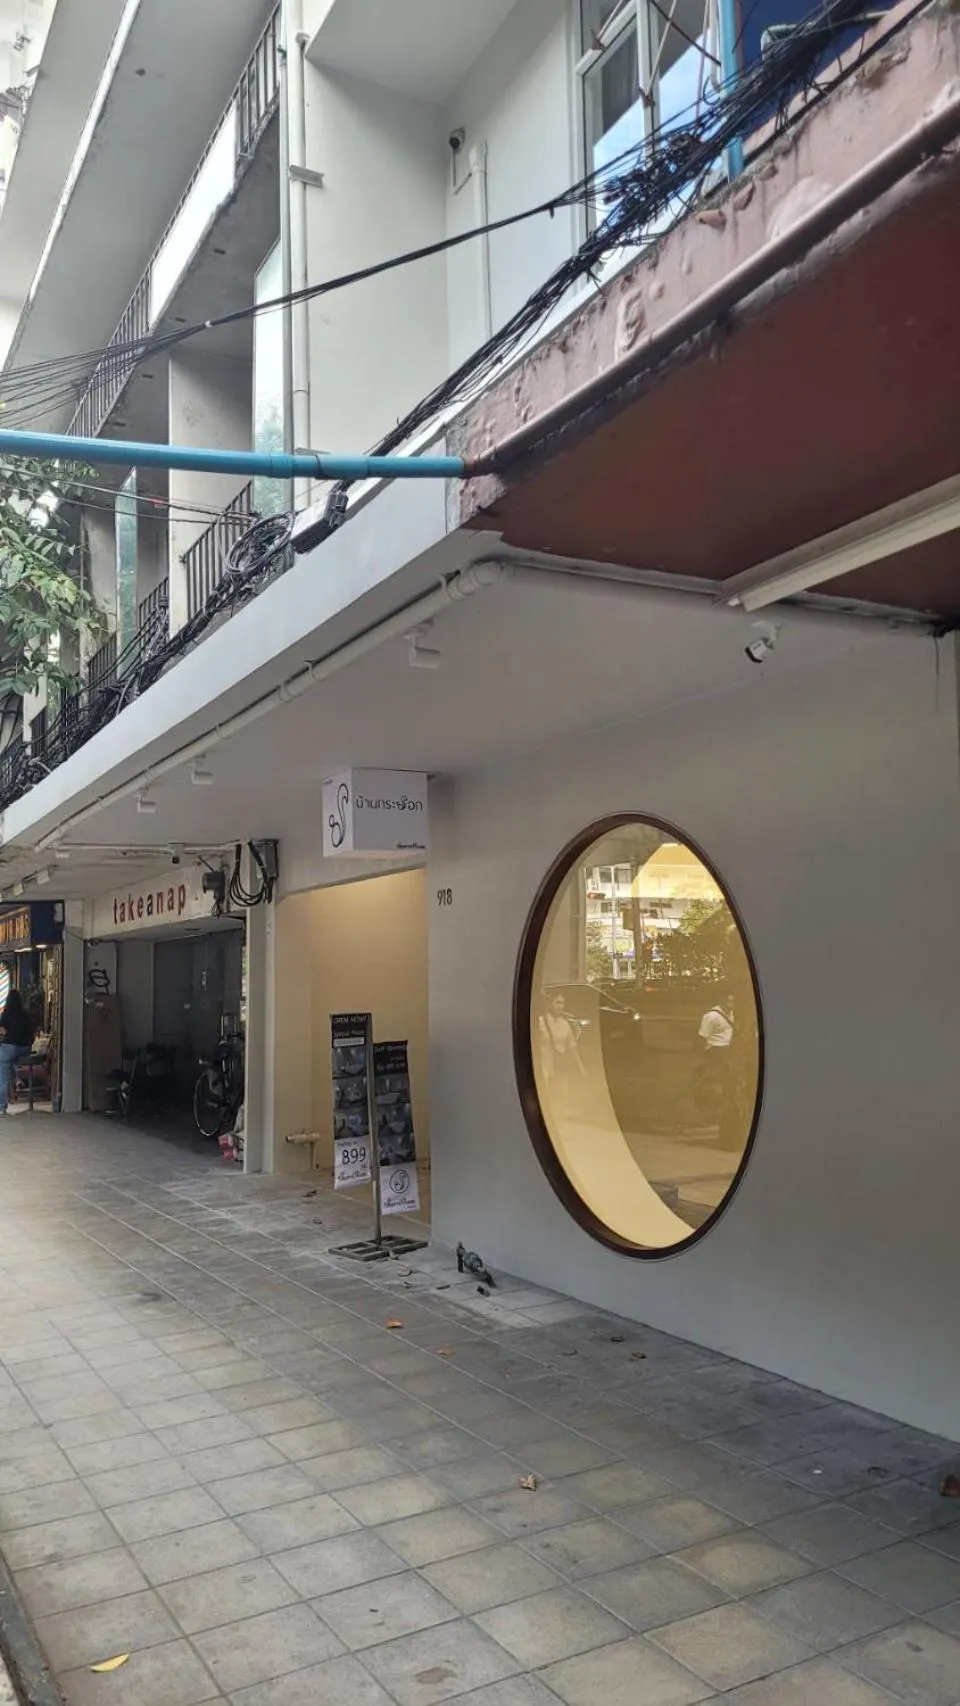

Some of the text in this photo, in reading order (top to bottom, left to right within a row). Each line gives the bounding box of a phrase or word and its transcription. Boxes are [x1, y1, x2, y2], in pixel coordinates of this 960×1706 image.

[112, 884, 187, 926] takeanap
[437, 887, 453, 906] 918
[341, 1146, 366, 1165] 899
